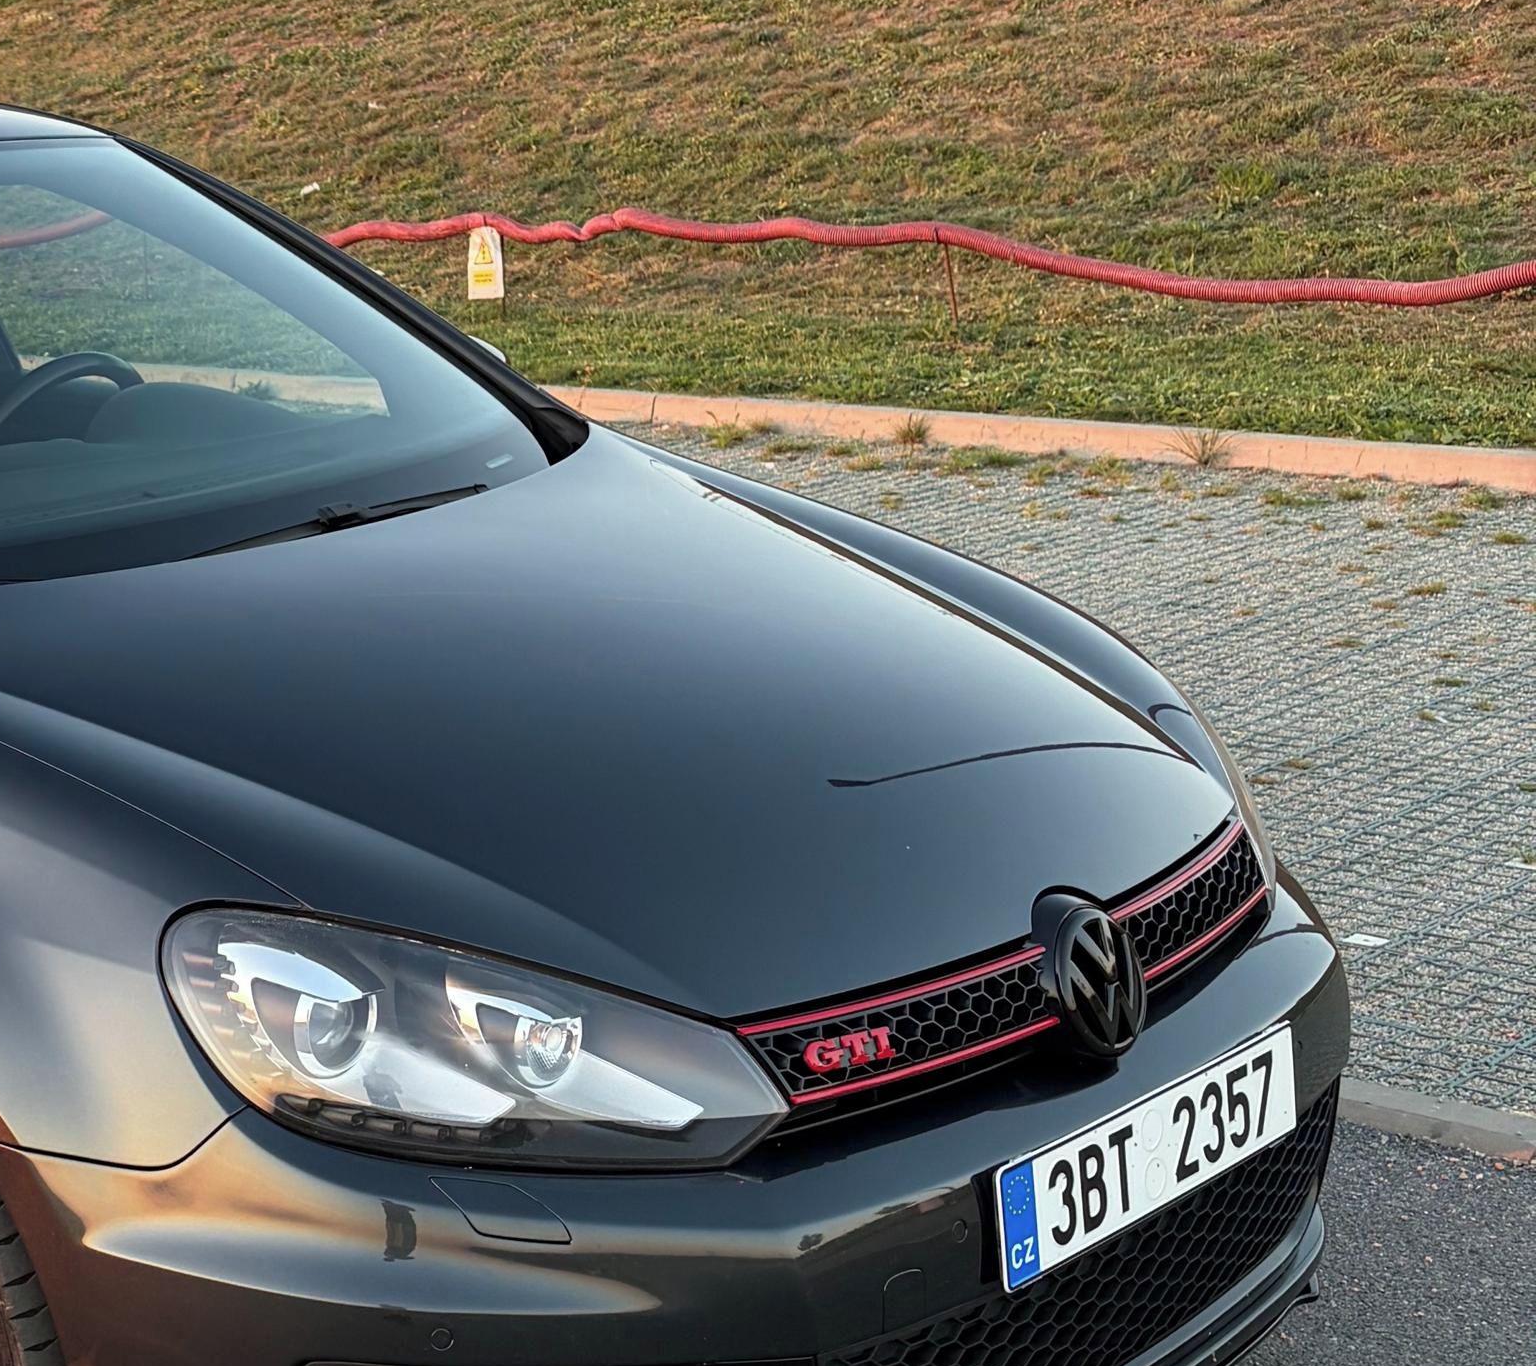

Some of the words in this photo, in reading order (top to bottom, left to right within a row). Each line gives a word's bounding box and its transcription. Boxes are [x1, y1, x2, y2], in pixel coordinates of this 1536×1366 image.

[803, 1025, 896, 1073] GTI
[1048, 1124, 1134, 1246] 3BT
[1172, 1050, 1273, 1184] 2357
[1011, 1236, 1035, 1270] CZ
